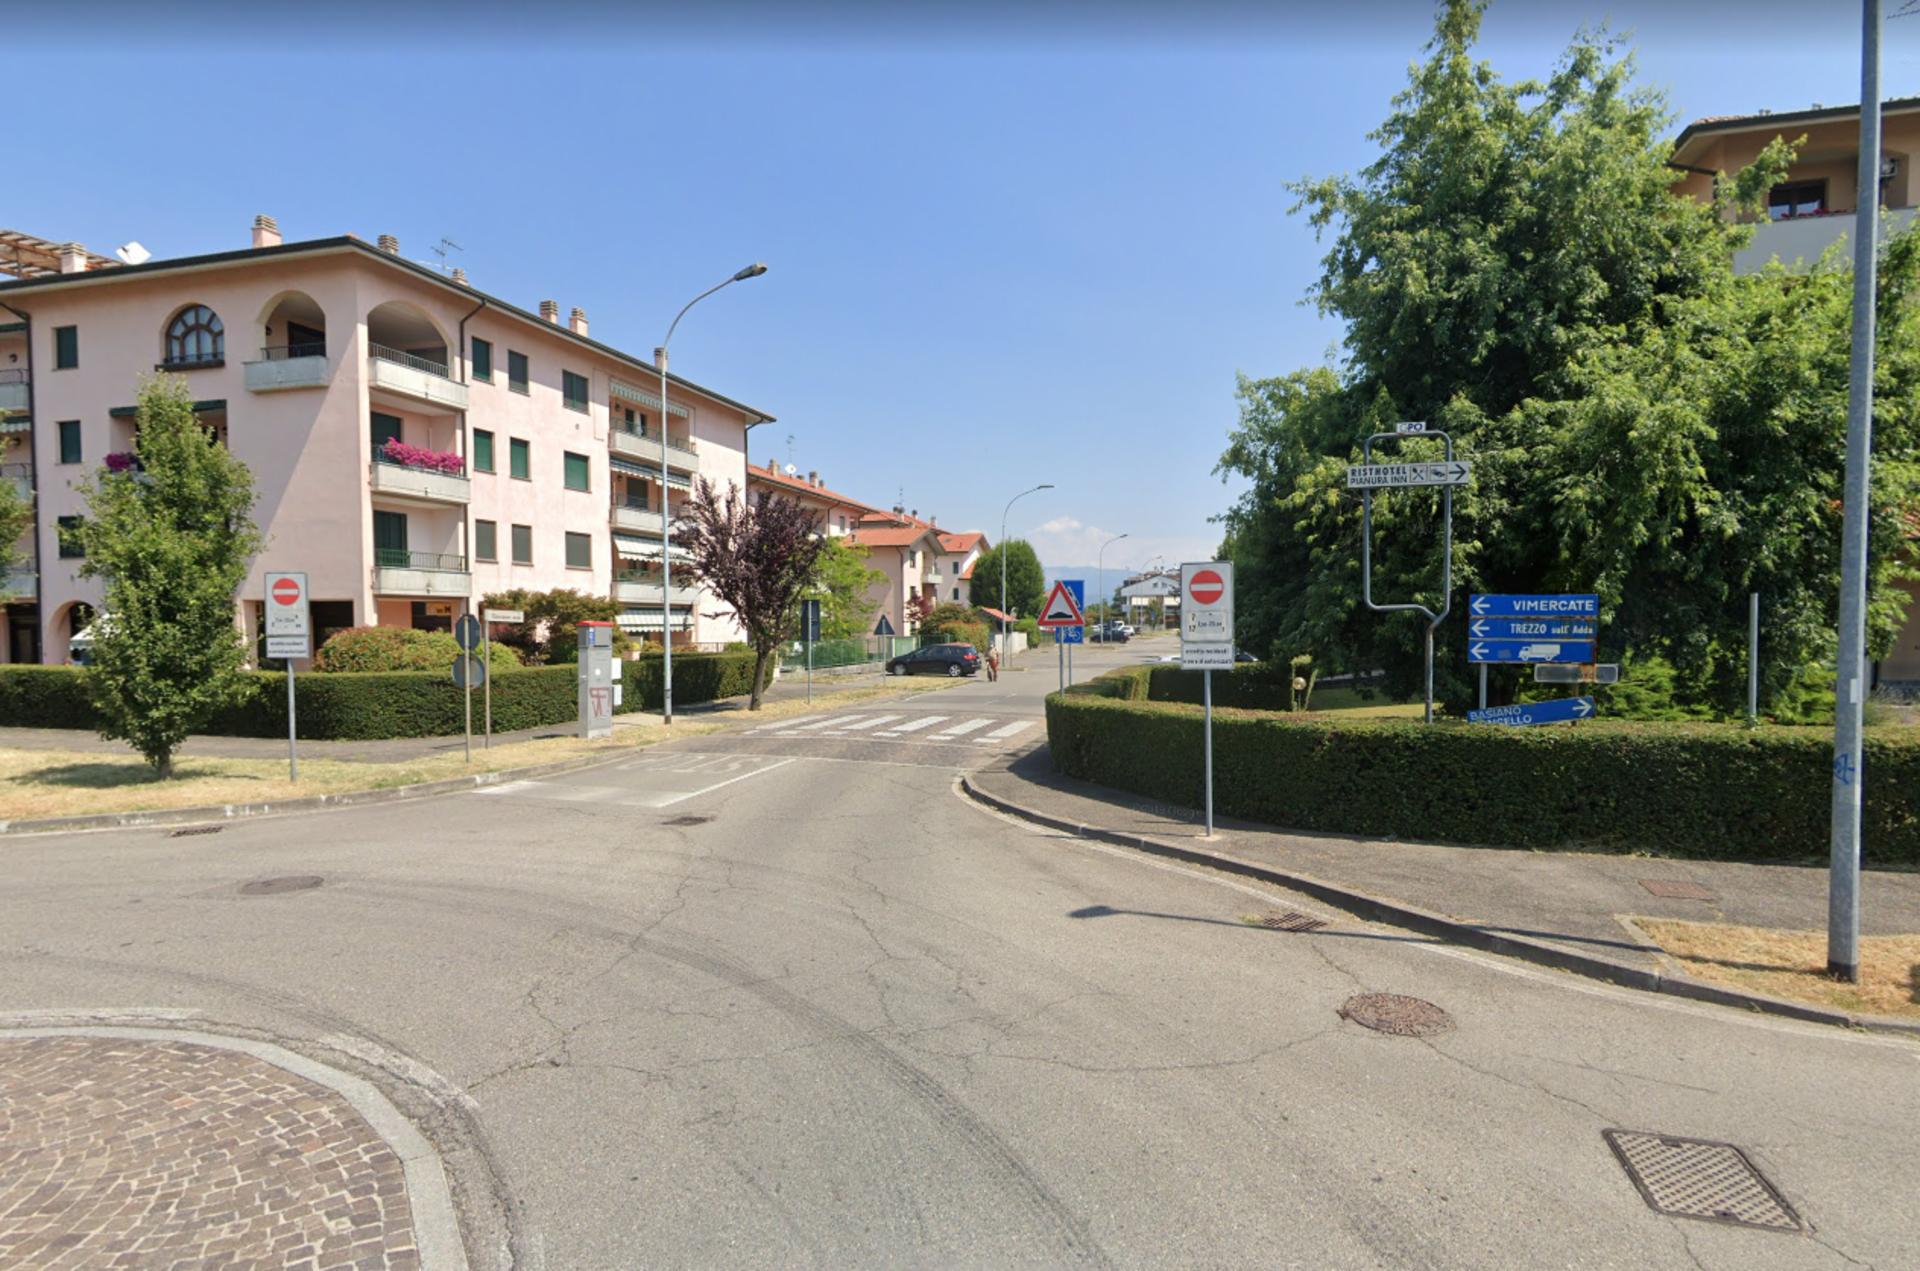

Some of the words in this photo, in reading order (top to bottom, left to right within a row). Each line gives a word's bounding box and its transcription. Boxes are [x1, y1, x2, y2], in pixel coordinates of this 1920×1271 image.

[1513, 600, 1594, 611] VIMERCATE
[1510, 623, 1547, 634] TREZZO
[1572, 625, 1593, 634] Adda
[1470, 706, 1521, 721] BASIANO
